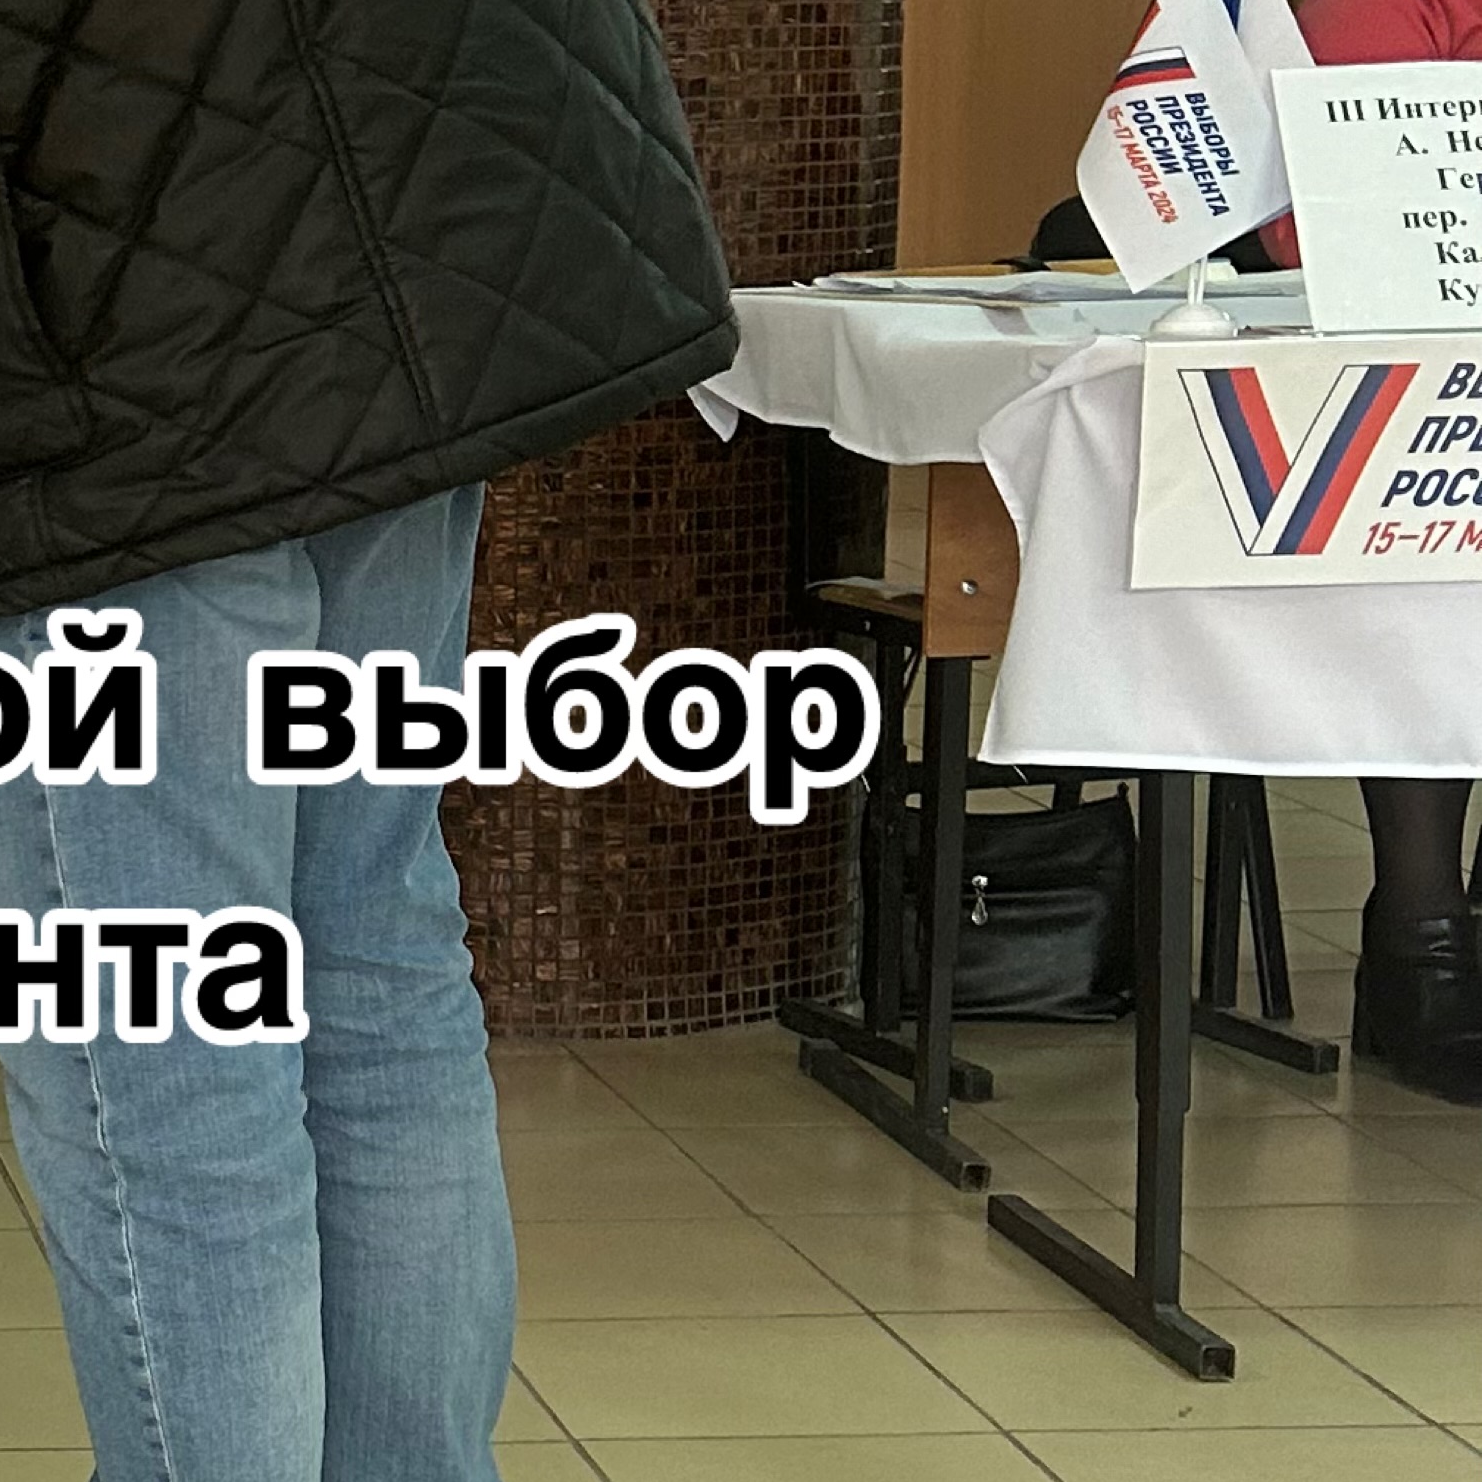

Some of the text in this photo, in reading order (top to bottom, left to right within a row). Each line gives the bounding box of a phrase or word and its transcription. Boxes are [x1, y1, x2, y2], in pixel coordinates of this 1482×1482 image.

[1375, 97, 1482, 122] Интер
[1125, 99, 1184, 175] РОССИИ
[1154, 95, 1230, 217] ПРЕЗИДЕНТА
[1184, 92, 1240, 176] ВЫБОРЫ
[1396, 131, 1429, 156] А.
[1120, 143, 1161, 189] МАРТА
[1402, 209, 1468, 234] пер.
